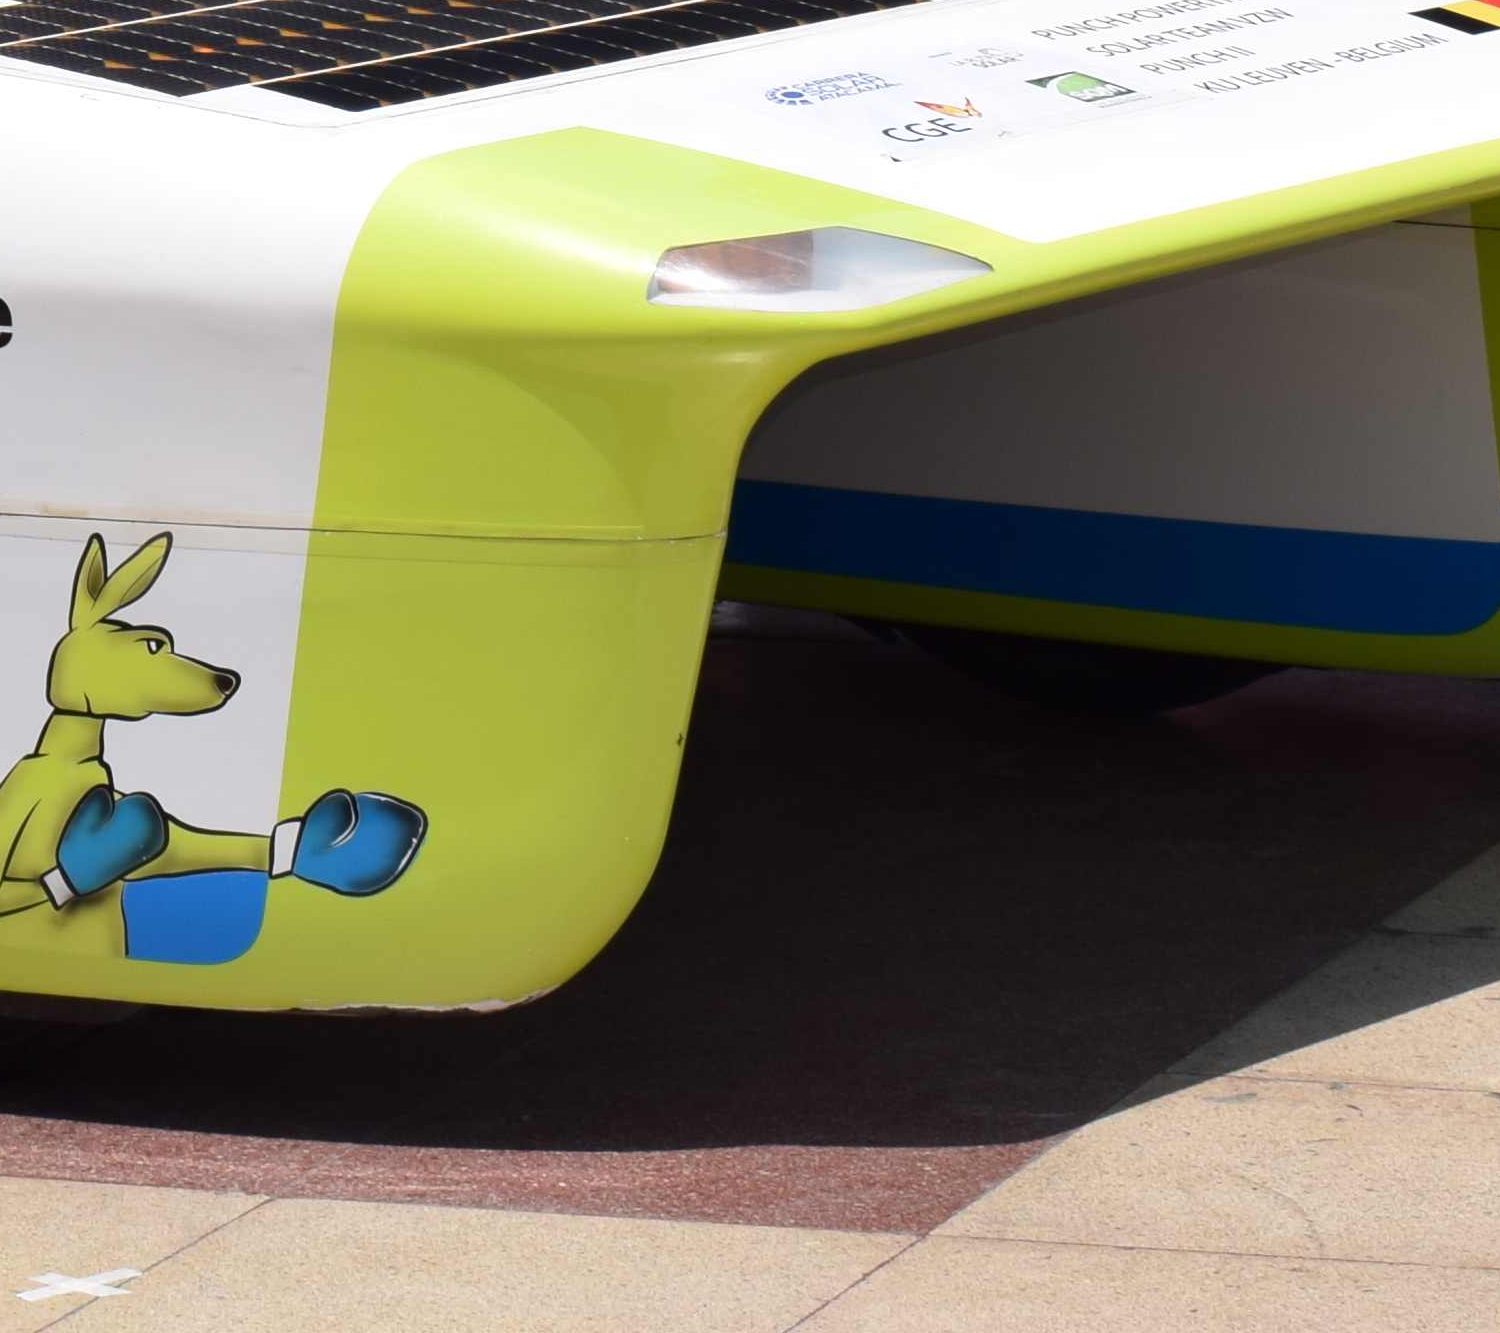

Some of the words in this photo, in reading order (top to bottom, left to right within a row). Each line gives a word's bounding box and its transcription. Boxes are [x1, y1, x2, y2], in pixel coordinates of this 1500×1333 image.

[1030, 13, 1132, 41] PUNCH
[1234, 7, 1295, 26] VZW
[1139, 48, 1234, 75] PUNCH
[1193, 74, 1242, 95] KU
[1243, 57, 1337, 87] LEUVEN
[1335, 32, 1450, 64] BELGIUM
[880, 117, 973, 143] CGE
